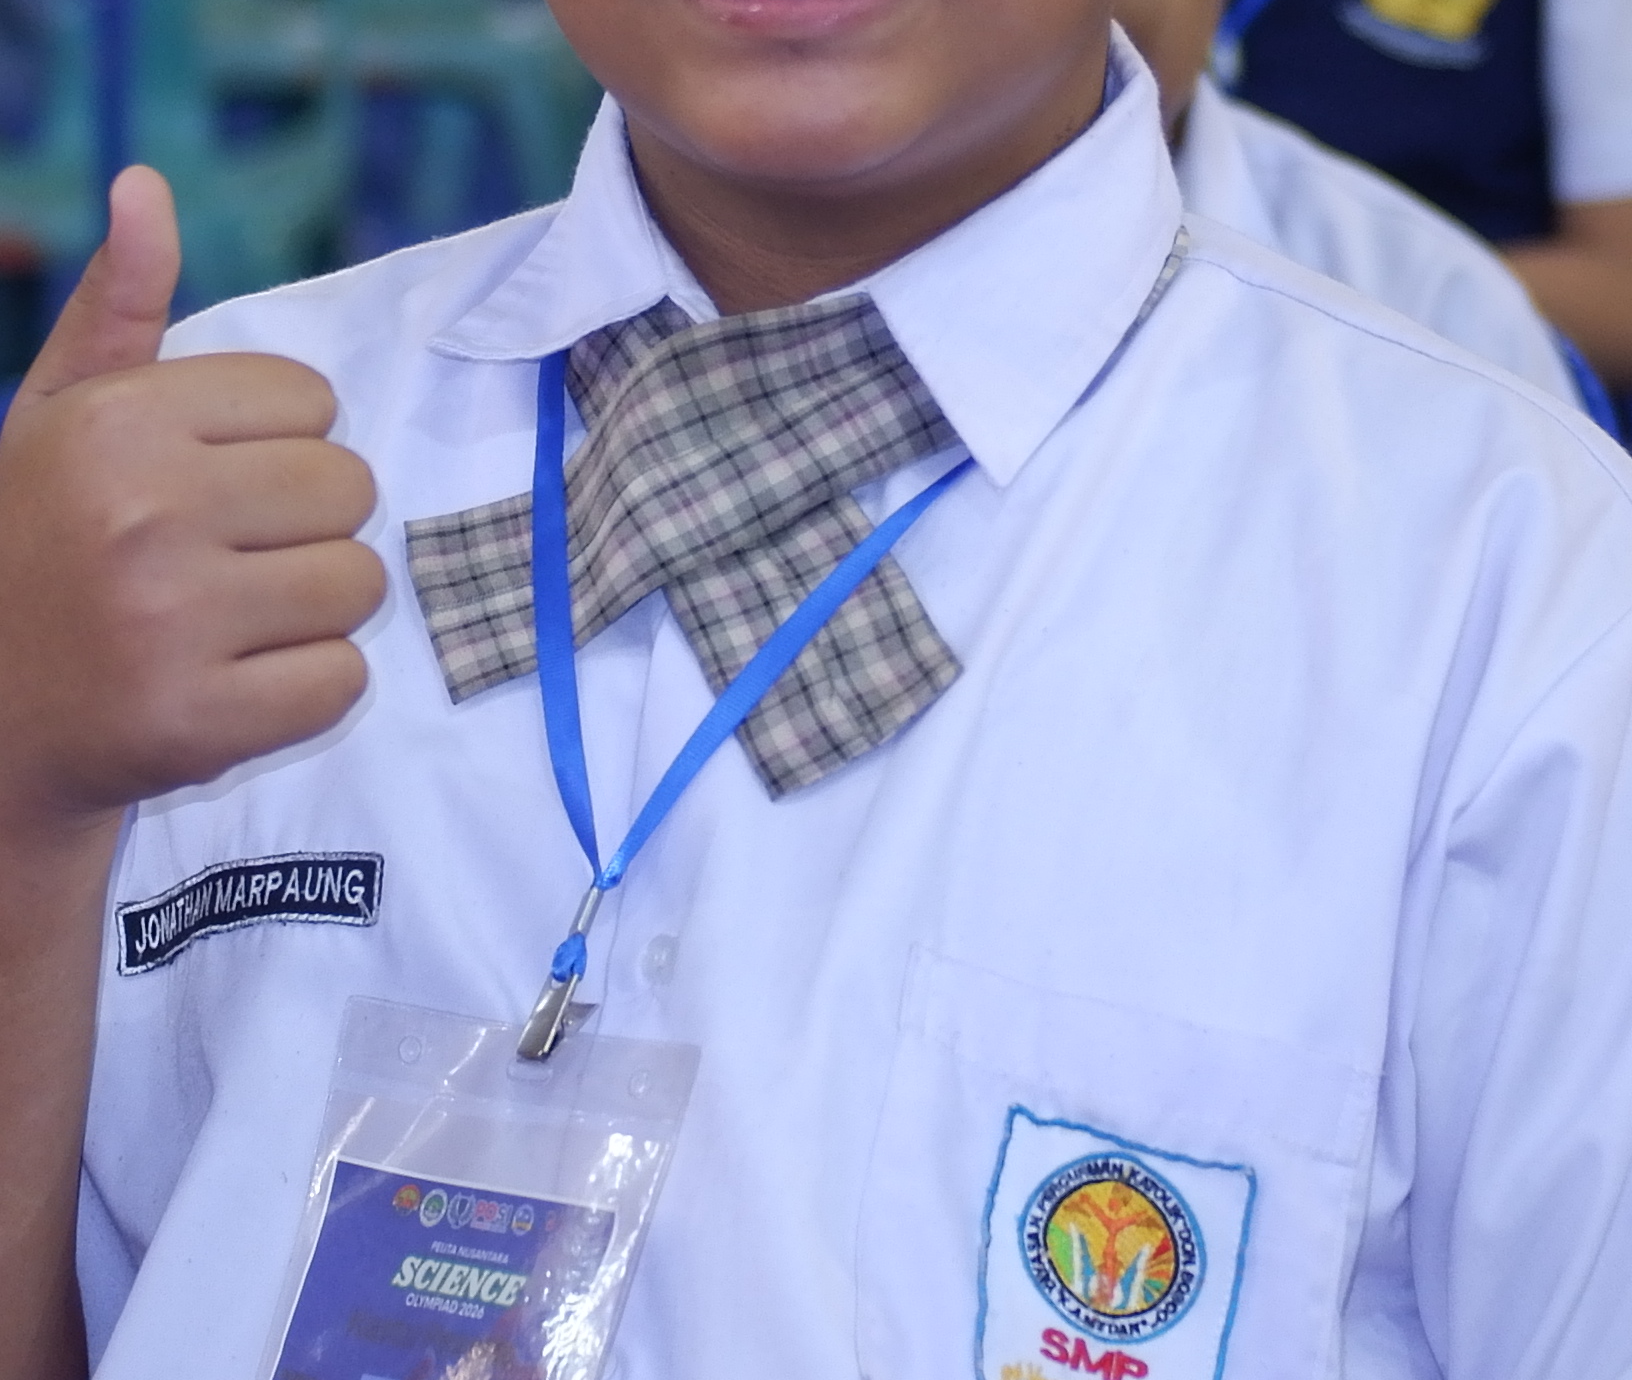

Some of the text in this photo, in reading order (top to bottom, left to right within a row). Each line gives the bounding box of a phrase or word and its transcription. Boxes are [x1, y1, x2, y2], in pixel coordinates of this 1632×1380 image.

[135, 866, 365, 953] JONATHAN MARPAUNG
[1130, 1166, 1185, 1225] KATOLIK
[392, 1256, 527, 1306] SCIENCE
[405, 1292, 485, 1320] OLYMPIAD 2026
[1040, 1327, 1149, 1380] SMP
